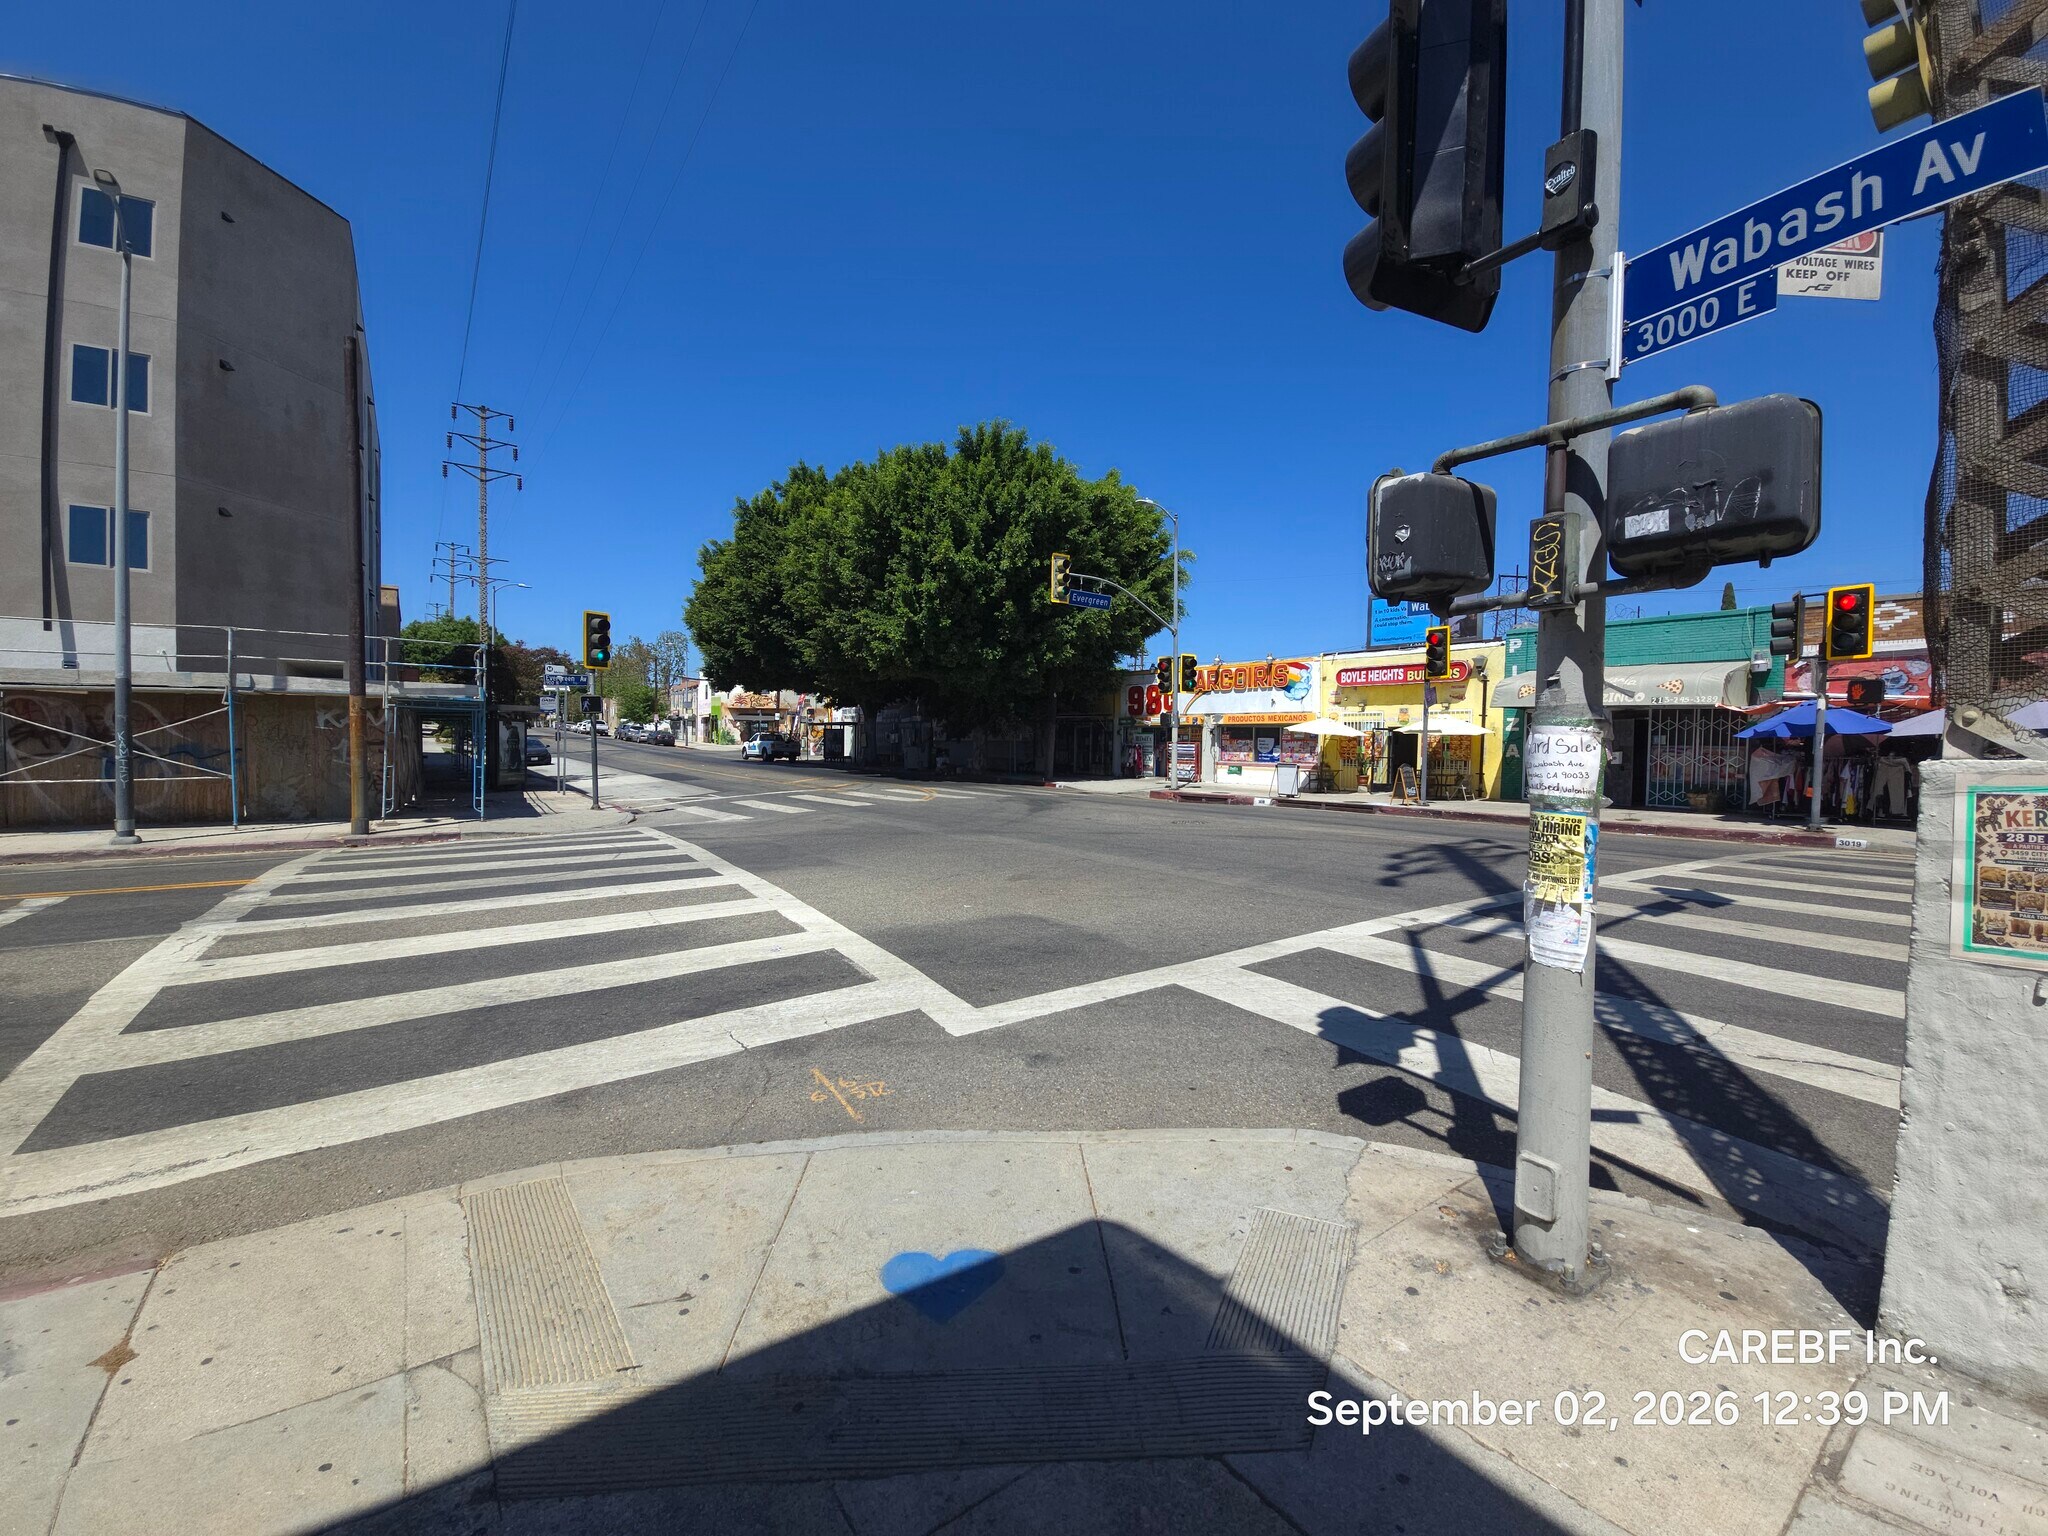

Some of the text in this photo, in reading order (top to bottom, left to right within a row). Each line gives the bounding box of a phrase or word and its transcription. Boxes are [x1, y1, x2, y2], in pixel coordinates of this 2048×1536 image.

[1670, 131, 1987, 292] Wabash Av
[1795, 256, 1875, 271] VOLTAGE WIRES
[1786, 268, 1850, 281] KEEP OFF
[1636, 281, 1757, 353] 3000 E
[1072, 593, 1109, 606] Evergreen
[1195, 664, 1289, 691] ARCOIRIS
[1340, 671, 1367, 683] BOYLE
[1368, 668, 1404, 681] HEIGHTS
[1506, 638, 1522, 757] PIZA
[1227, 714, 1308, 723] PRODUCTOS MEXICANOS
[1561, 771, 1589, 779] 90033
[1542, 821, 1581, 836] HIRING
[1839, 840, 1862, 848] 3019
[2006, 833, 2045, 843] 28 DE
